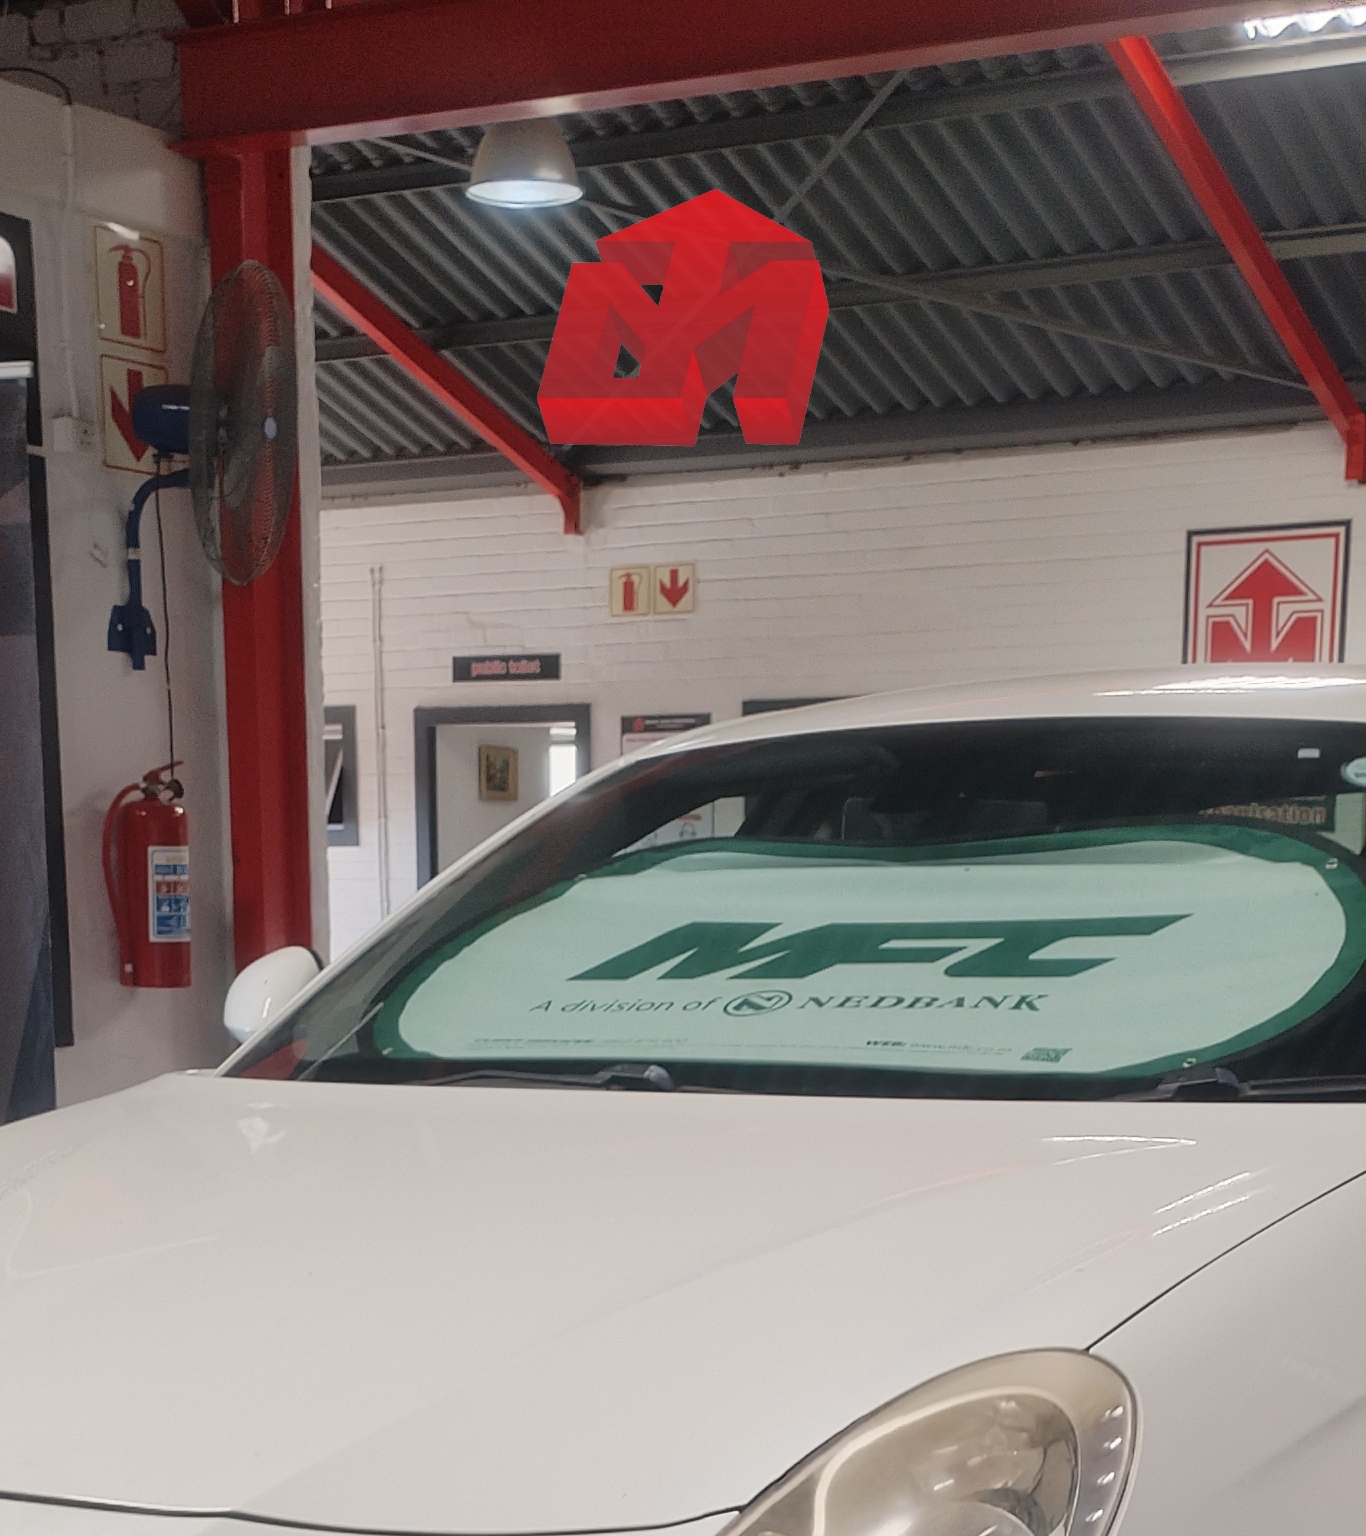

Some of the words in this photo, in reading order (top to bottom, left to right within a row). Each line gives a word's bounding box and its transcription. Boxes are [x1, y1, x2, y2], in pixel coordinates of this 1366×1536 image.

[567, 913, 1193, 981] MFC
[529, 1000, 552, 1012] A
[561, 999, 673, 1012] division
[682, 997, 722, 1011] of
[797, 995, 1050, 1011] NEDBANK
